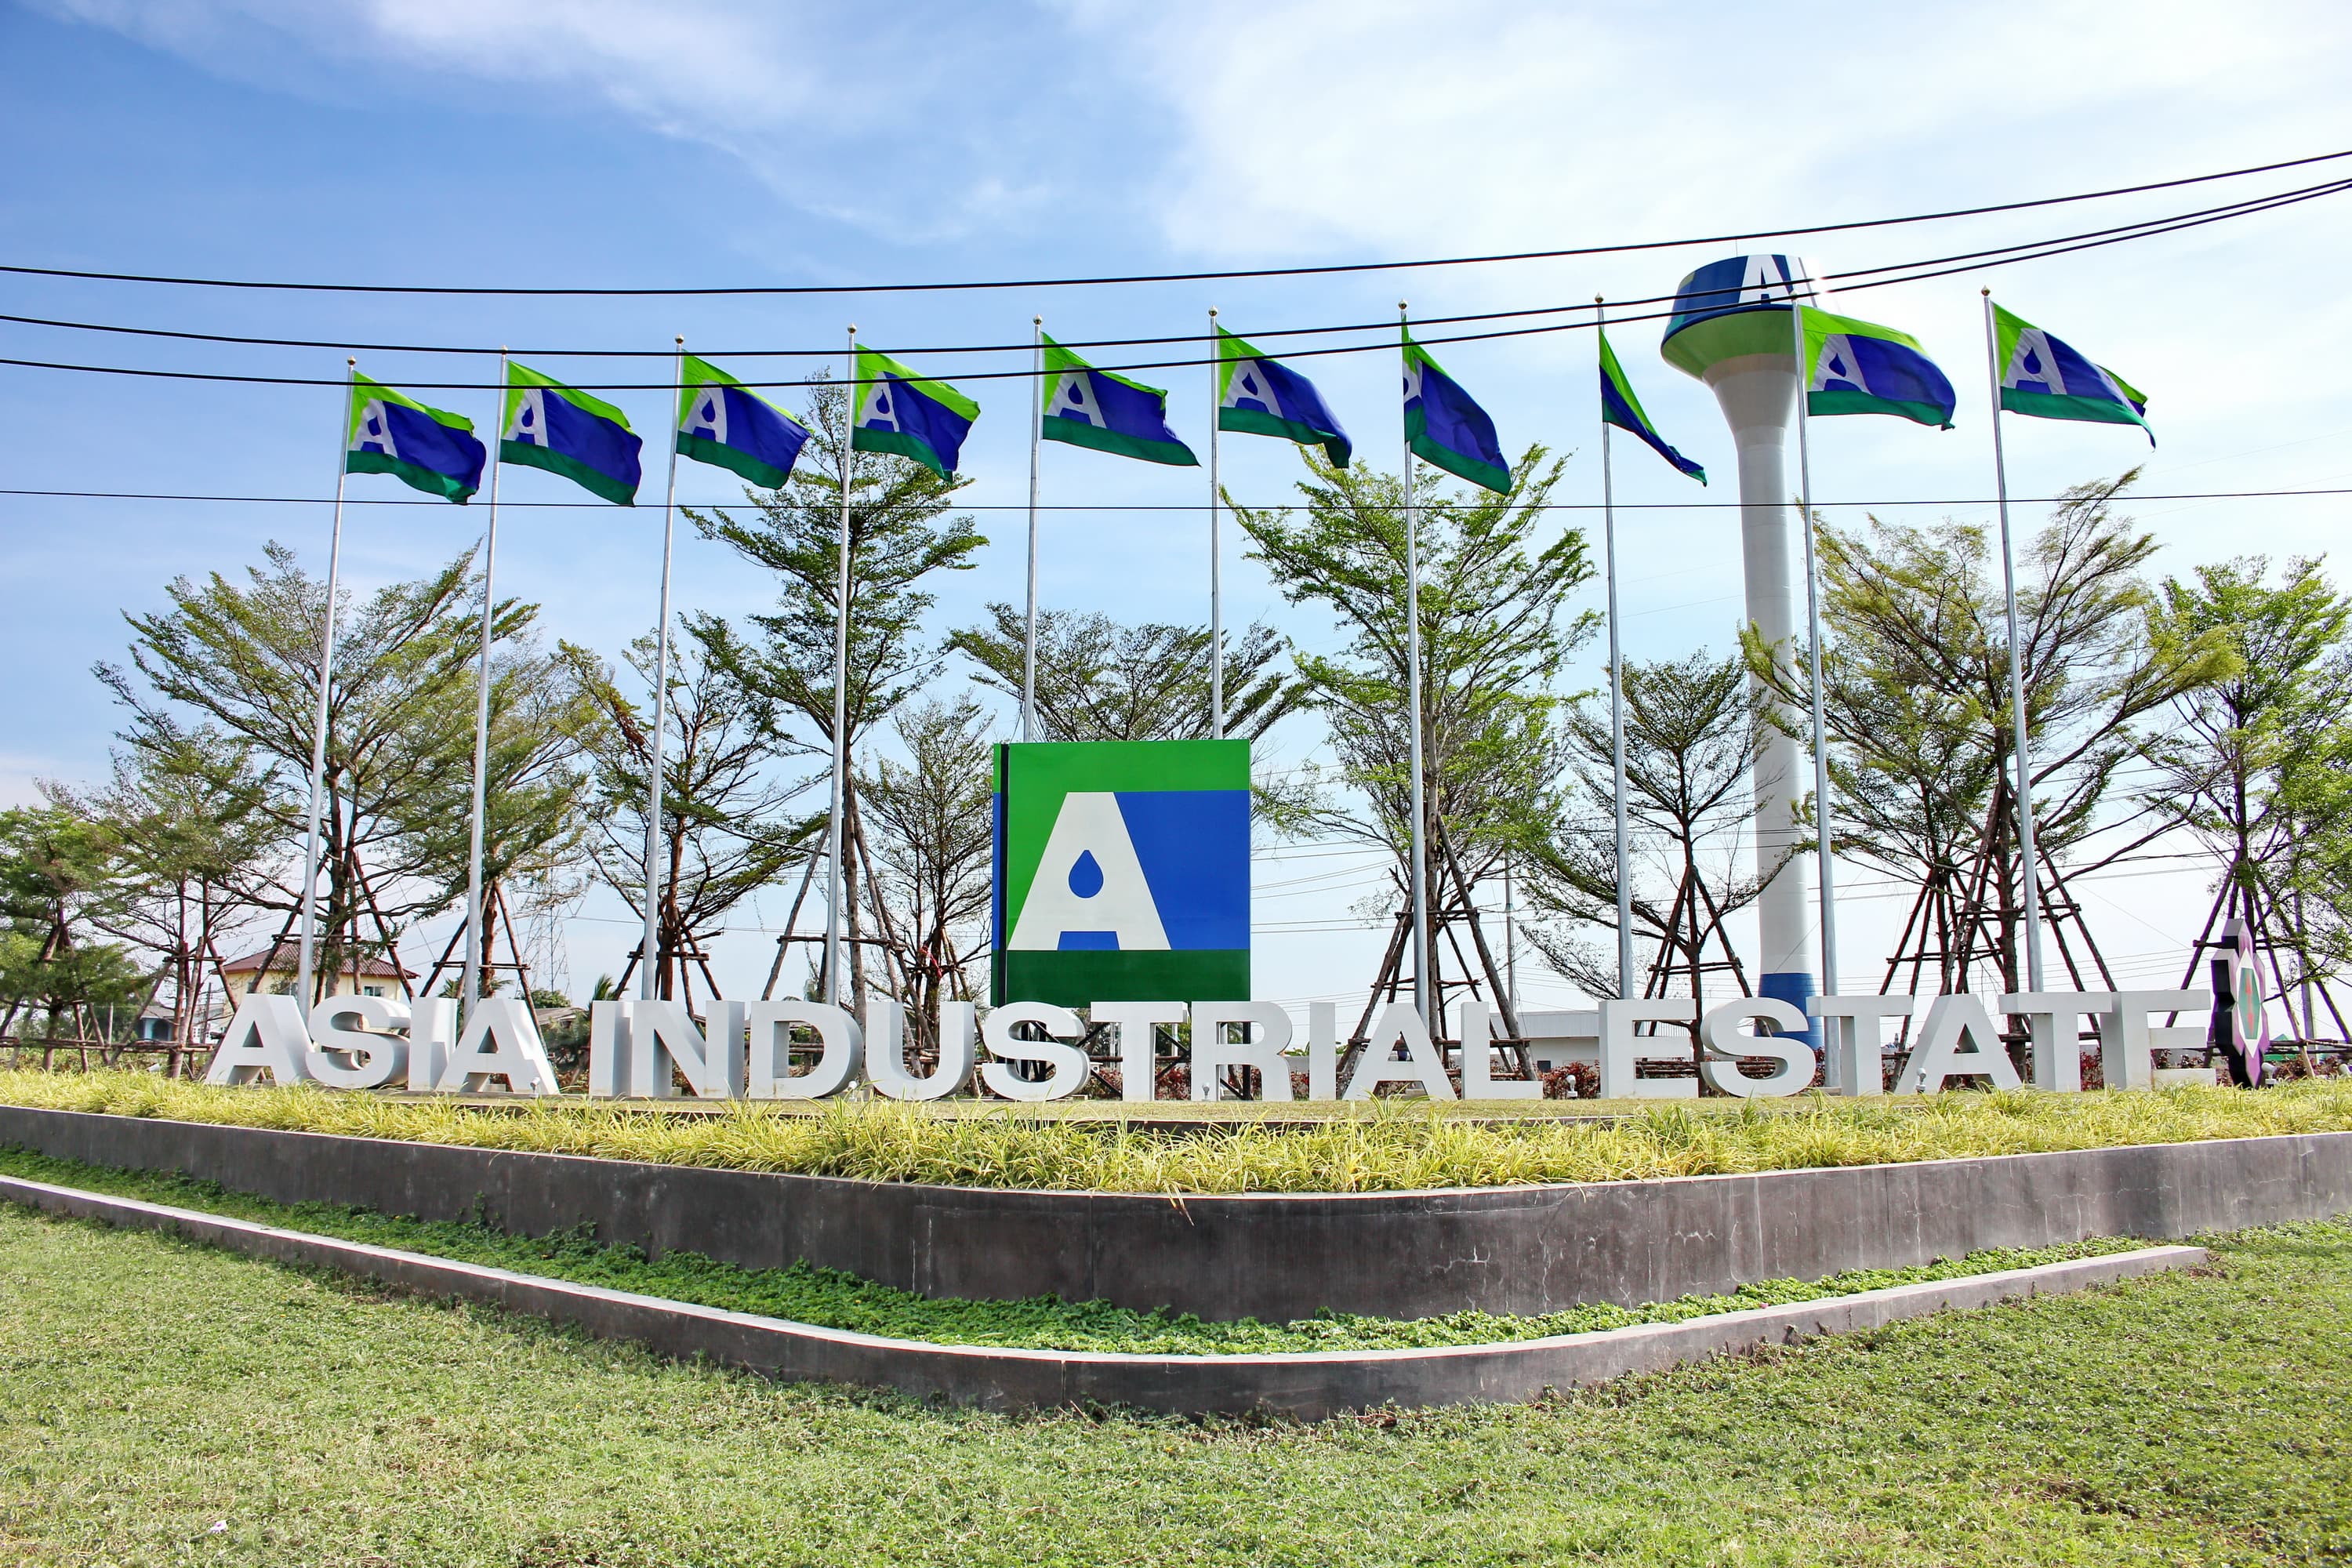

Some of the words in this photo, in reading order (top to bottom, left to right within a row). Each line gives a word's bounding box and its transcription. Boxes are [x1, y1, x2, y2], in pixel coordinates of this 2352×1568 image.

[1738, 255, 1794, 306] A
[1221, 354, 1283, 419] A
[1809, 334, 1873, 395] A
[2000, 327, 2067, 395] A
[349, 397, 398, 459] A
[501, 387, 549, 448] A
[679, 379, 728, 445] A
[855, 371, 899, 433] A
[1047, 364, 1107, 429] A
[1007, 791, 1172, 951] A
[205, 993, 561, 1095] ASIA
[589, 1000, 1544, 1102] INDUSTRIAL
[1599, 989, 2217, 1098] ESTATE
